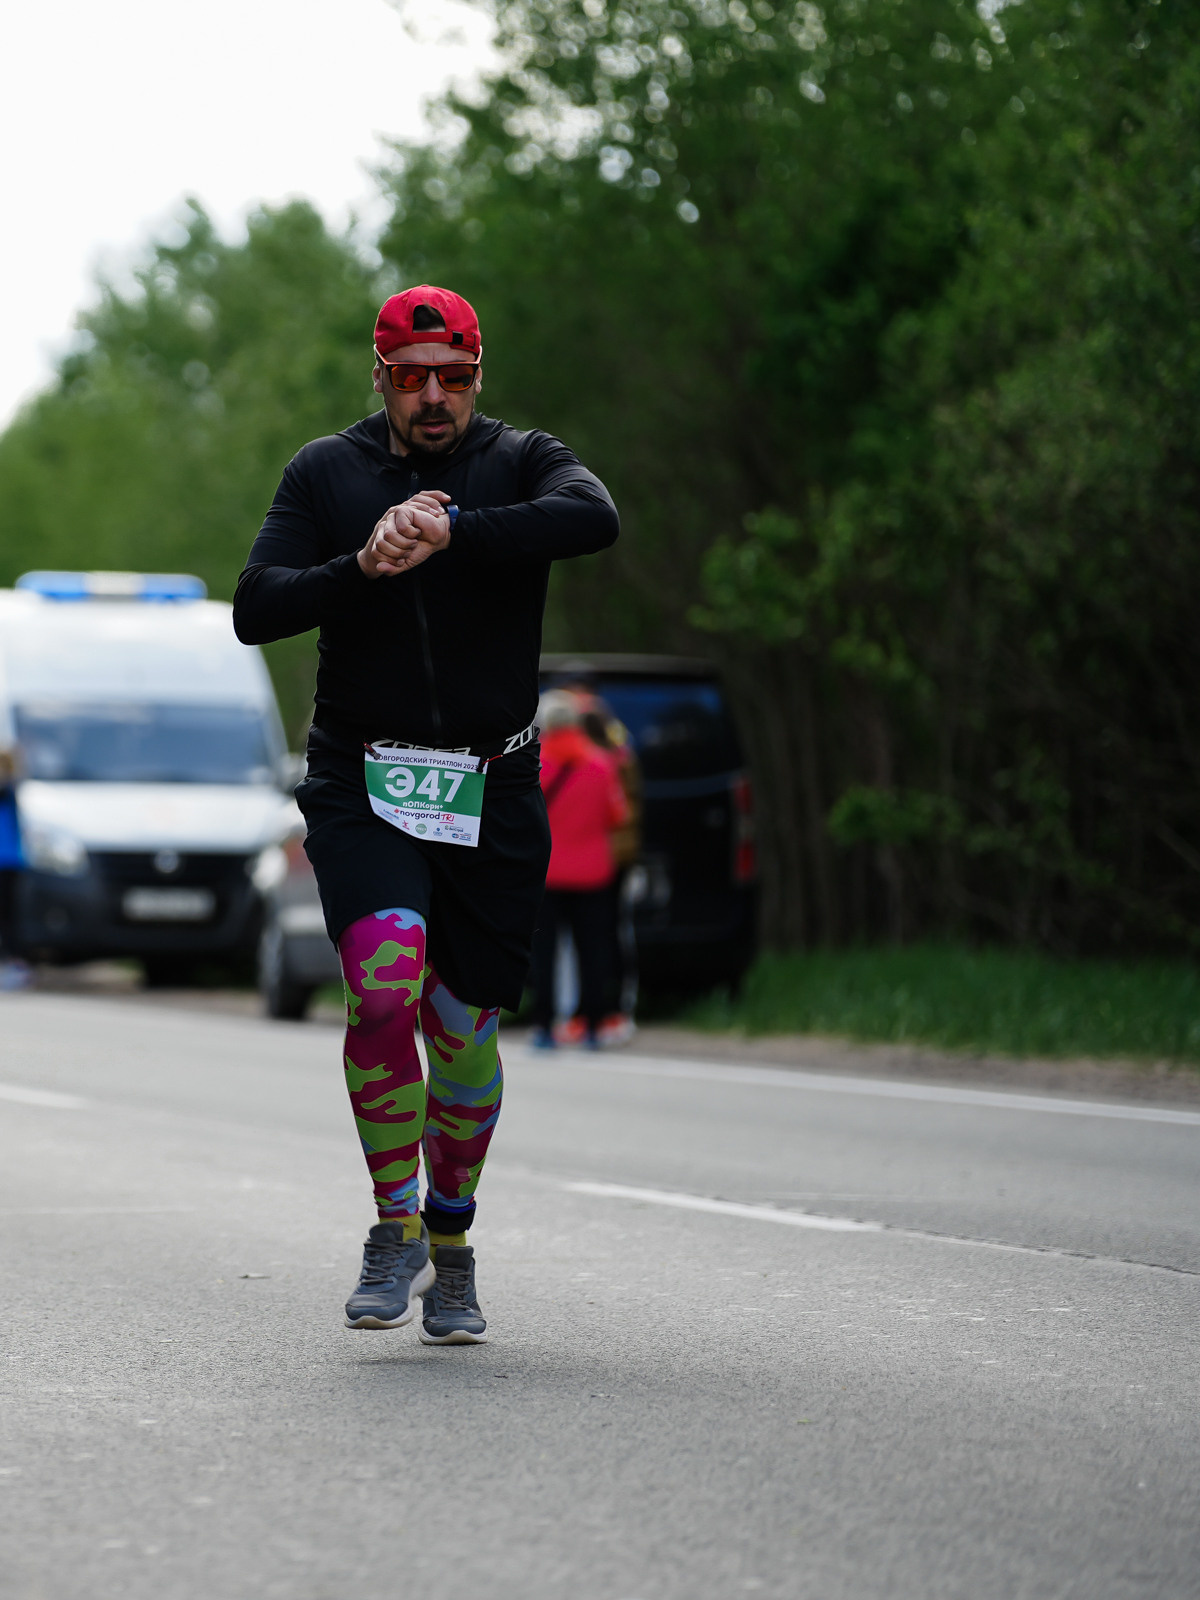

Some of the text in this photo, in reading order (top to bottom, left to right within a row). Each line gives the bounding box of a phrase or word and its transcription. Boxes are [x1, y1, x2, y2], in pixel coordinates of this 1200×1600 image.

[379, 755, 427, 765] ОВГОРОДСКИЙ
[429, 759, 462, 768] ТРИАТЛОН
[385, 766, 466, 803] Э47
